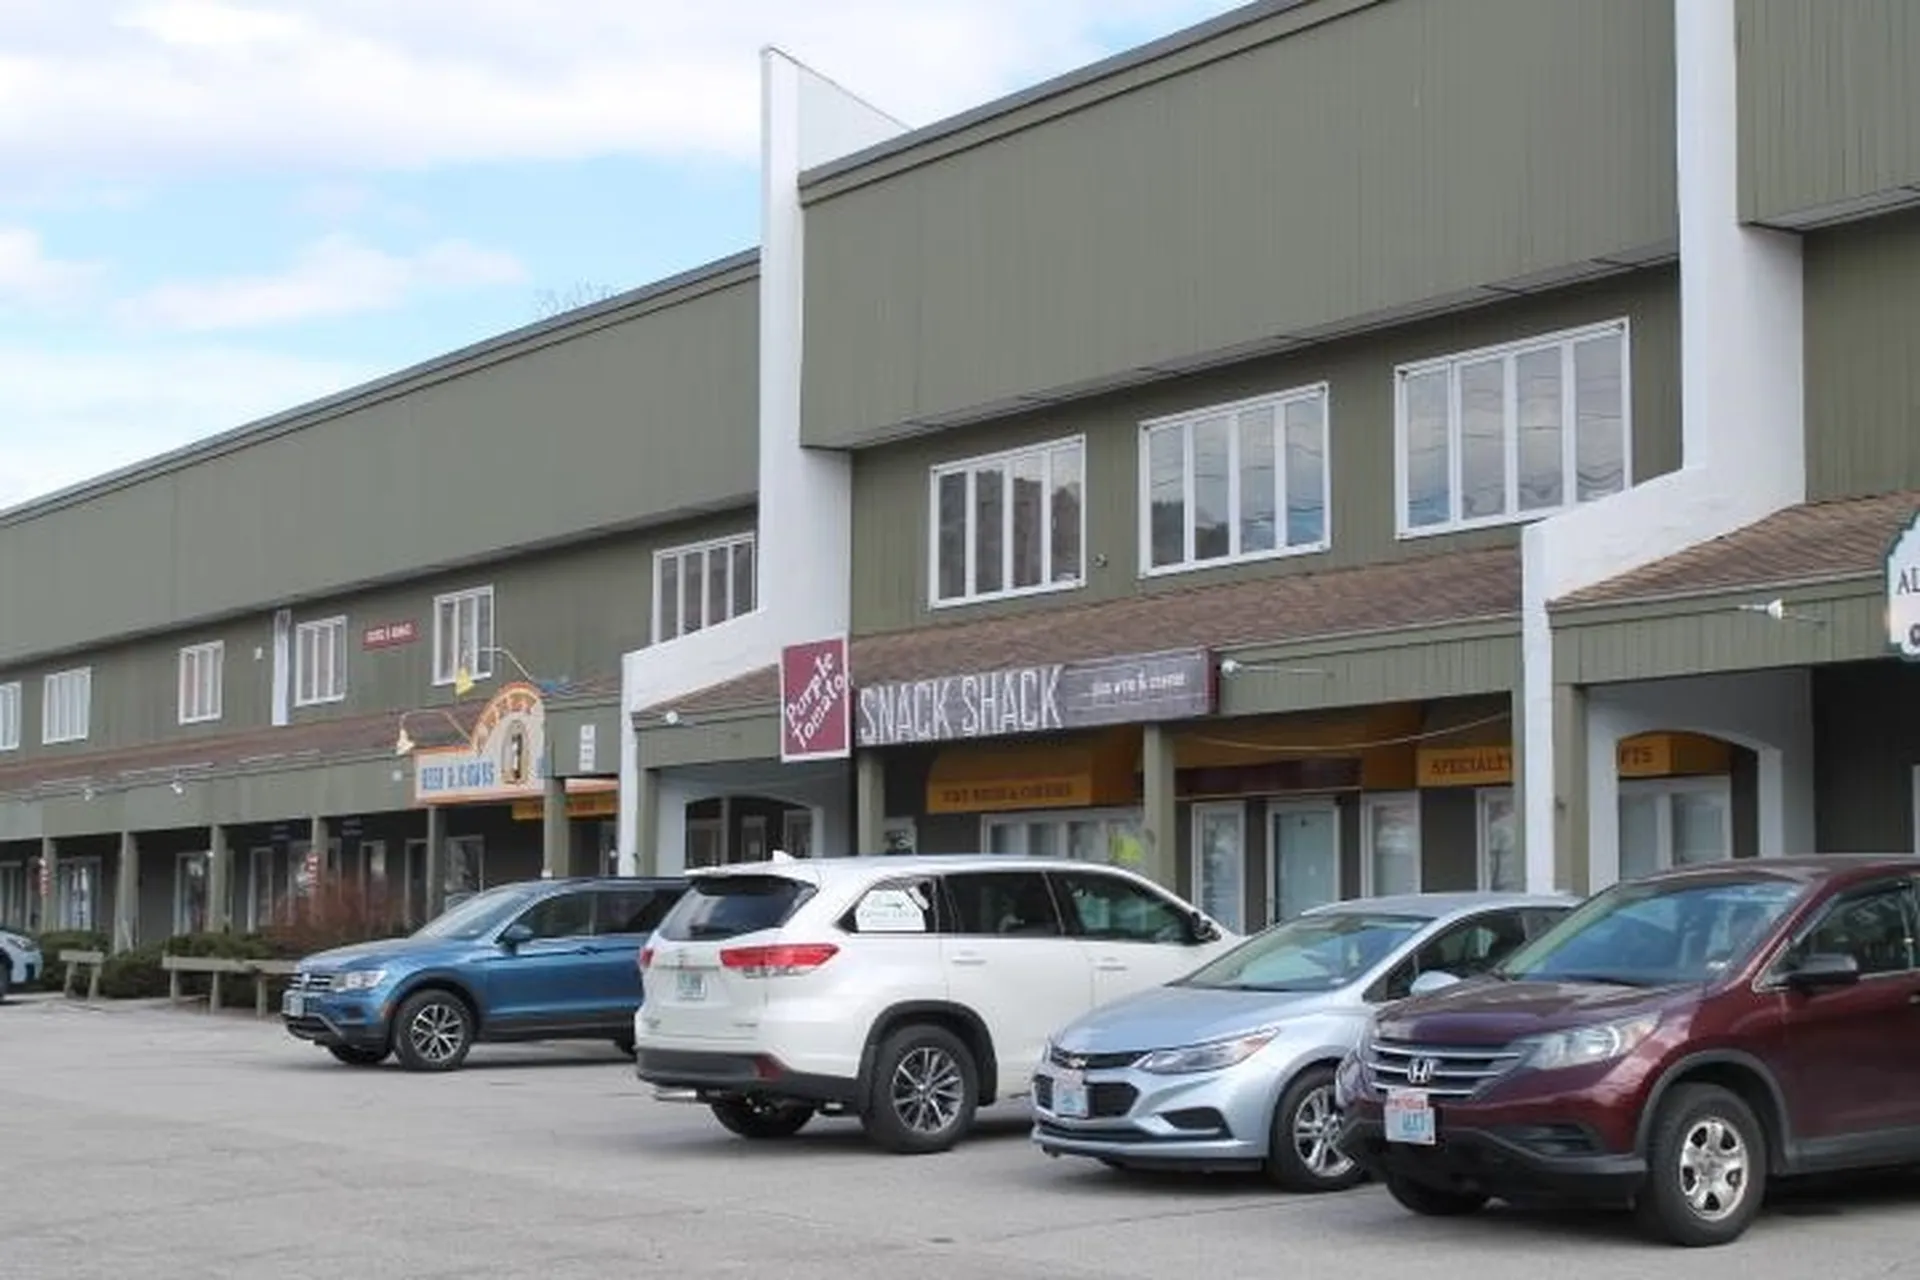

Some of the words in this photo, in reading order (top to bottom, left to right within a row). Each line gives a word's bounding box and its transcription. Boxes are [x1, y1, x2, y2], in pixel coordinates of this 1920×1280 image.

[786, 653, 833, 728] Purple
[792, 674, 845, 749] Tomato
[860, 681, 953, 746] SNACK
[961, 664, 1064, 737] SHACK
